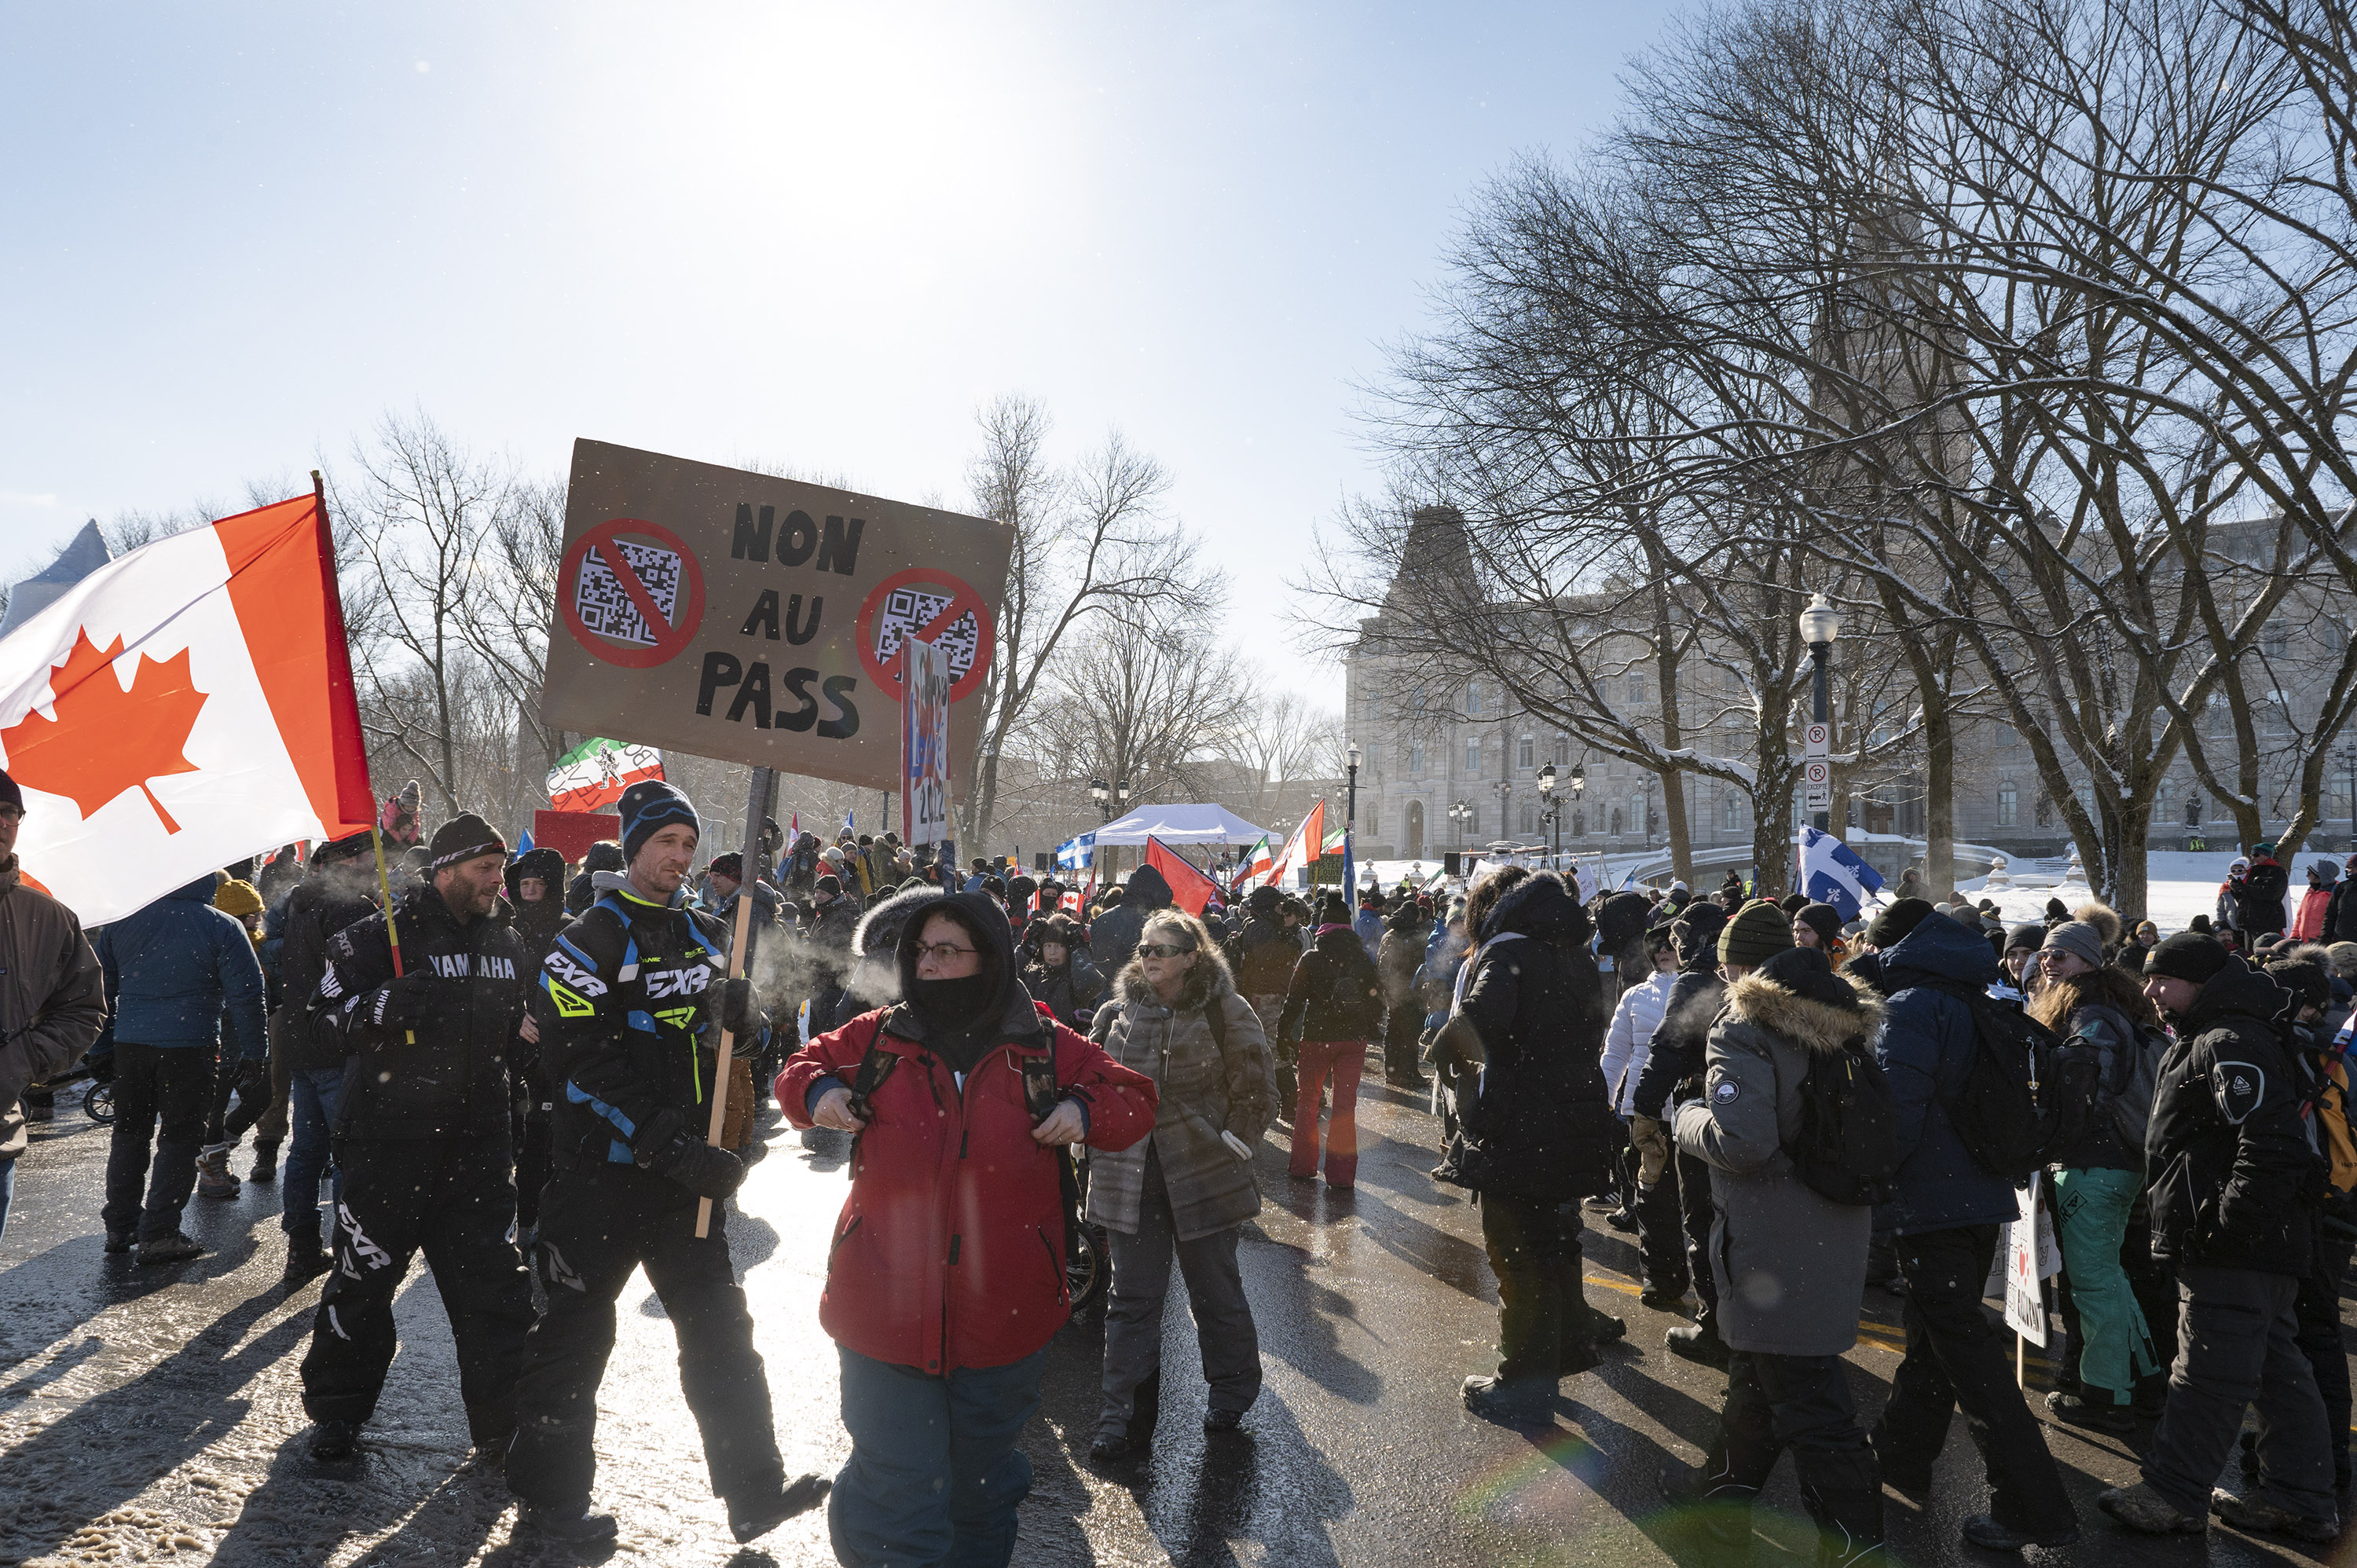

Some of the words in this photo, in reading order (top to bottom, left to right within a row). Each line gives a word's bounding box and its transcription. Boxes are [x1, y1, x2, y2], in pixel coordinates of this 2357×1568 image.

[731, 502, 867, 576] NON
[739, 588, 824, 646] AU
[695, 650, 861, 739] PASS
[428, 953, 516, 980] YAMAHA
[544, 950, 608, 997] FXR
[644, 963, 712, 999] FXR
[374, 989, 390, 1025] YAMAHA
[339, 1203, 391, 1269] FXR
